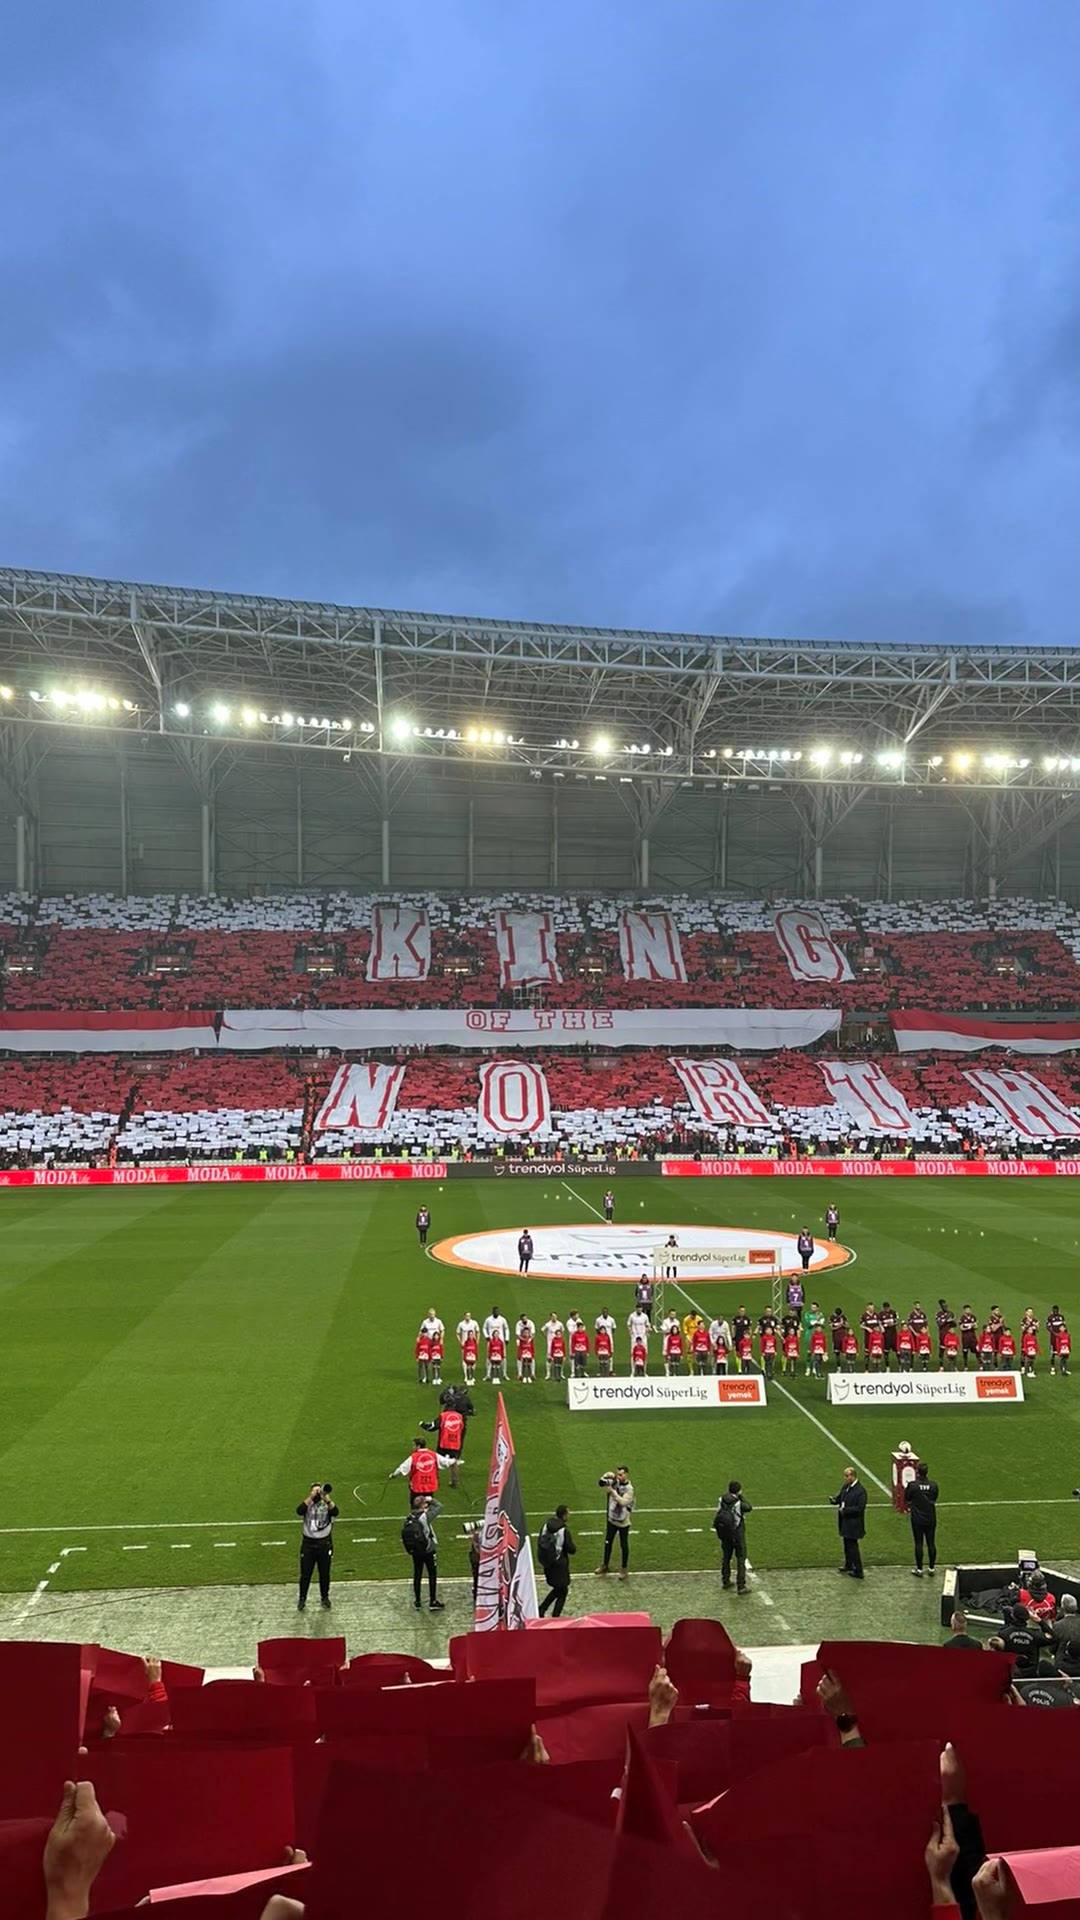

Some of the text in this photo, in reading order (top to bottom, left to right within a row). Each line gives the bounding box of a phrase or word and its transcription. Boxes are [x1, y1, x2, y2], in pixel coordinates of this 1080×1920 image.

[466, 1010, 614, 1030] OF THE
[186, 1167, 230, 1182] MODA
[265, 1166, 307, 1180] MODA
[340, 1165, 382, 1179] MODA
[509, 1163, 616, 1175] trendyol SüperLig
[701, 1161, 741, 1175] MODA
[773, 1161, 814, 1175] MODA
[841, 1161, 882, 1175] MODA
[914, 1161, 955, 1175] MODA
[987, 1161, 1028, 1175] MODA
[33, 1170, 77, 1184] MODA
[113, 1169, 157, 1183] MODA
[671, 1253, 711, 1263] trendyol
[712, 1253, 746, 1263] SüperLig
[793, 1293, 799, 1302] 7
[722, 1382, 756, 1392] trendyol
[853, 1381, 966, 1397] trendyol SüperLig
[979, 1378, 1013, 1388] trendyol
[593, 1385, 708, 1400] trendyol SüperLig
[727, 1391, 753, 1400] yemek
[985, 1387, 1010, 1396] yemek
